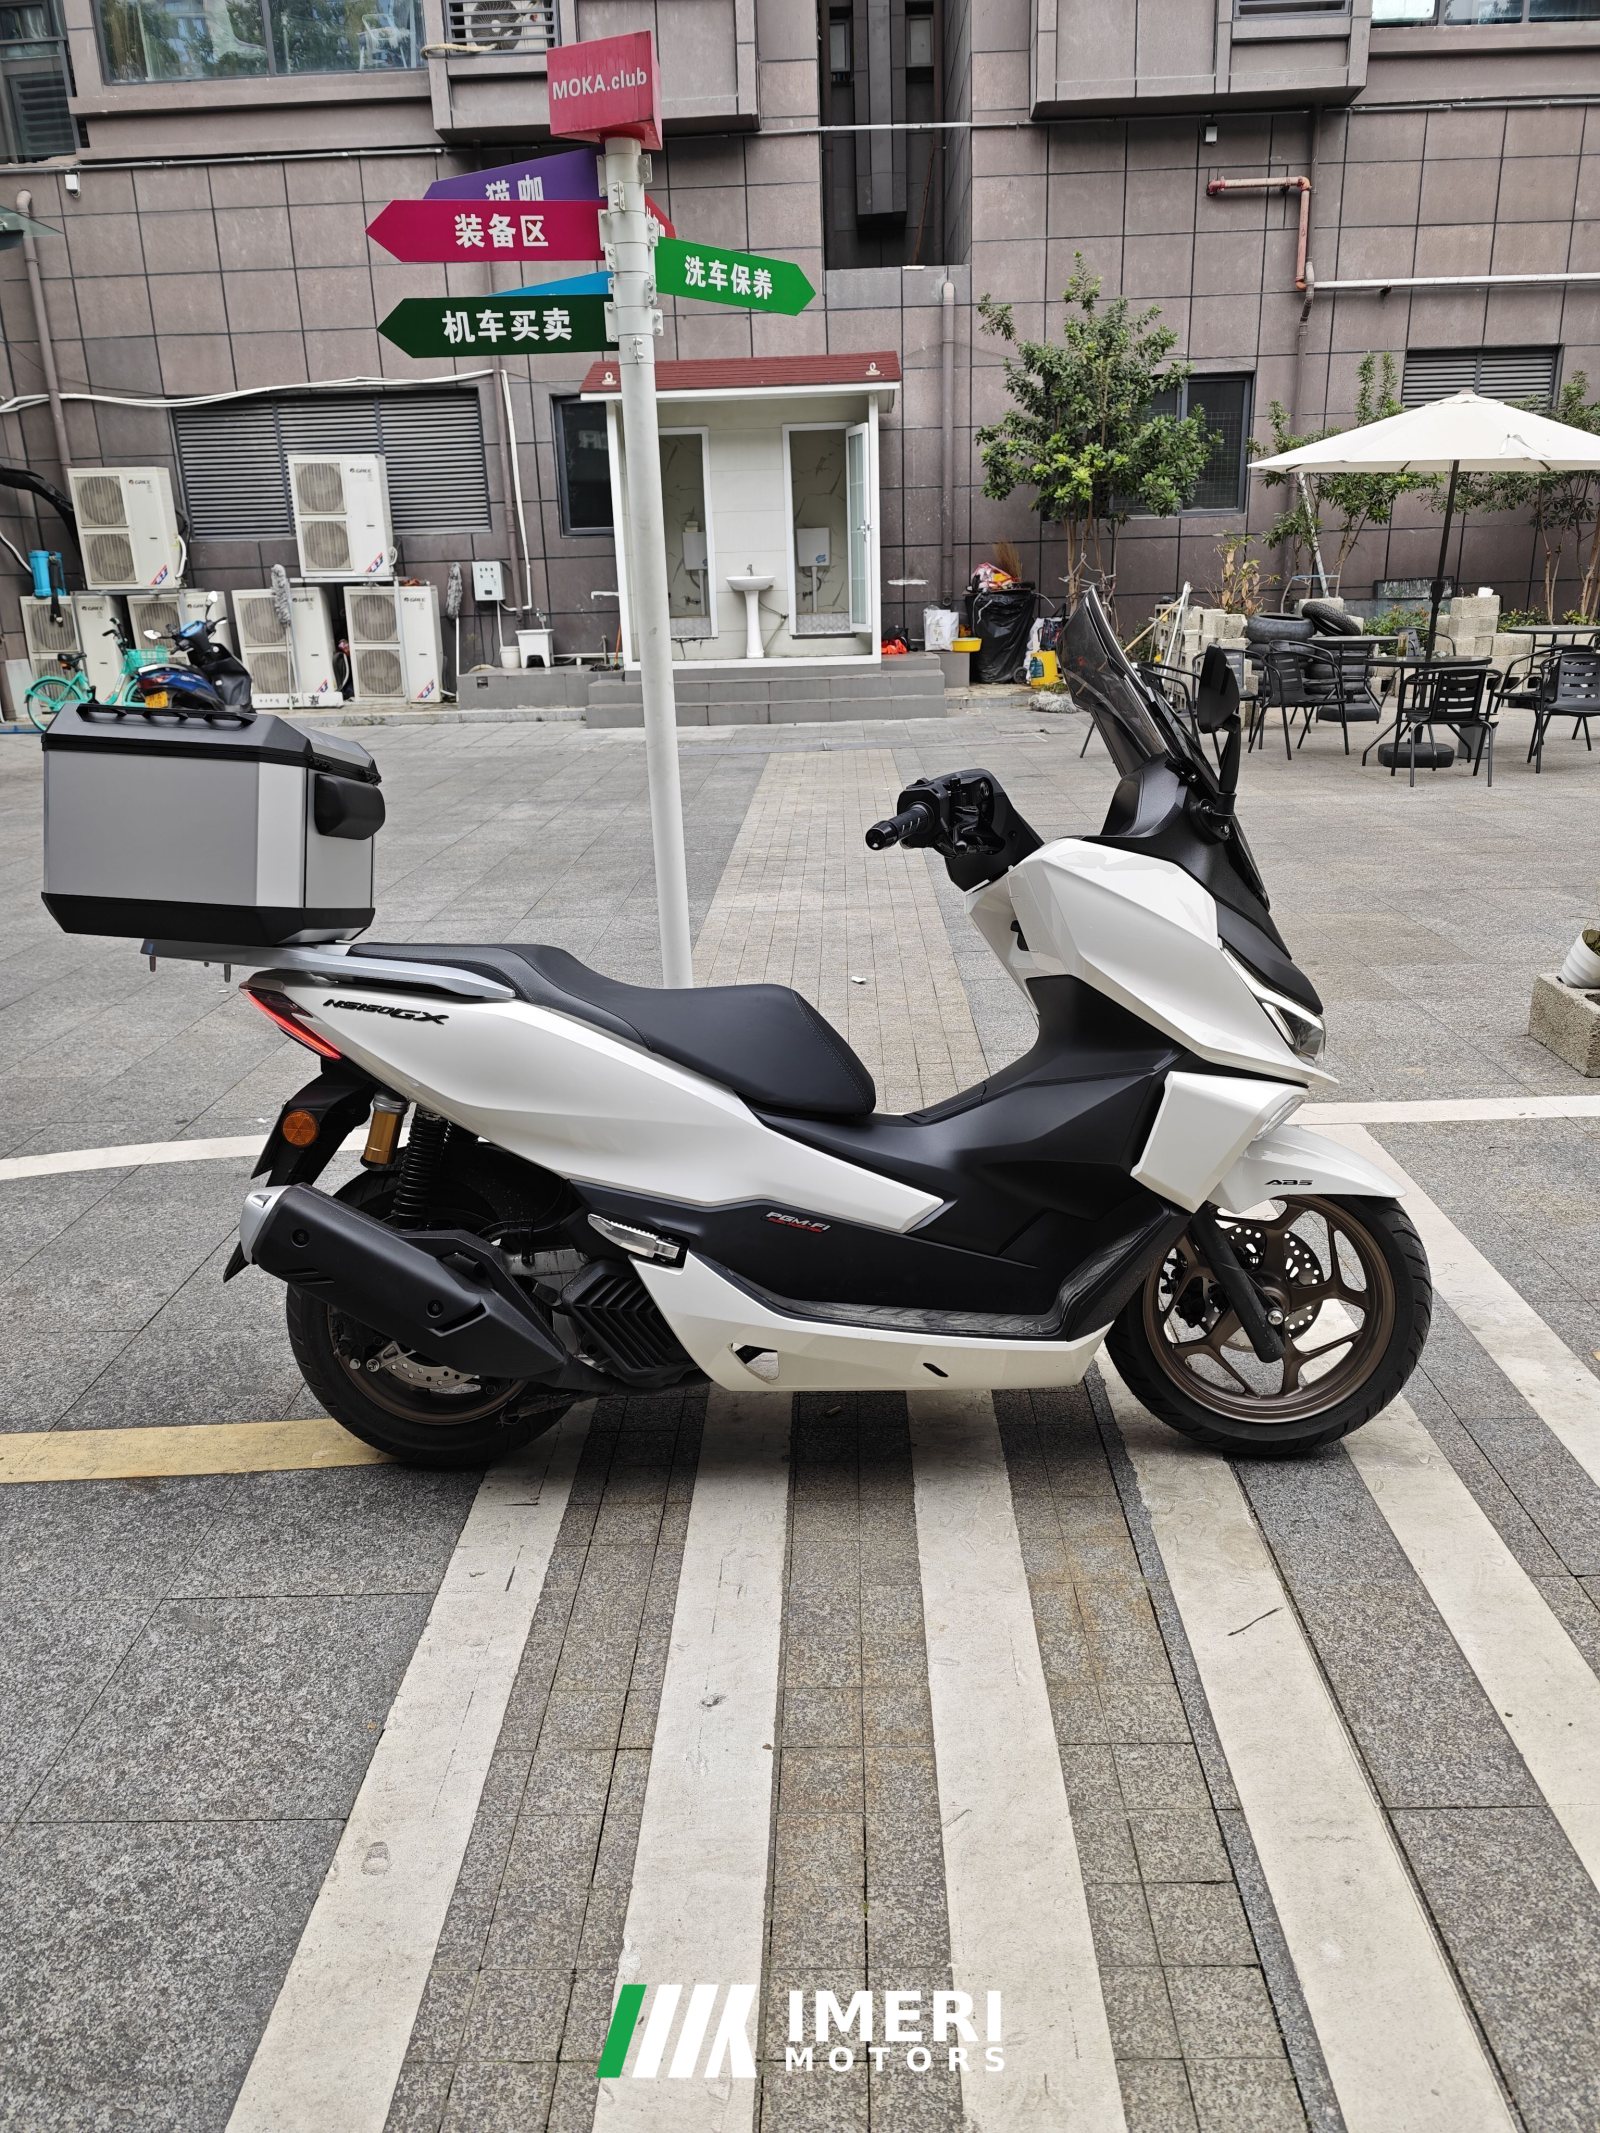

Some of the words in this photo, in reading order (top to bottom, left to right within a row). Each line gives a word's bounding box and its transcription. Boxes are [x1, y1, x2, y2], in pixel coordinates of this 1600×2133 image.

[552, 66, 647, 100] MOKA.club
[454, 213, 549, 249] 装备区
[684, 254, 773, 300] 洗车保养
[441, 307, 573, 344] 机车买卖
[322, 999, 450, 1026] NS150GX
